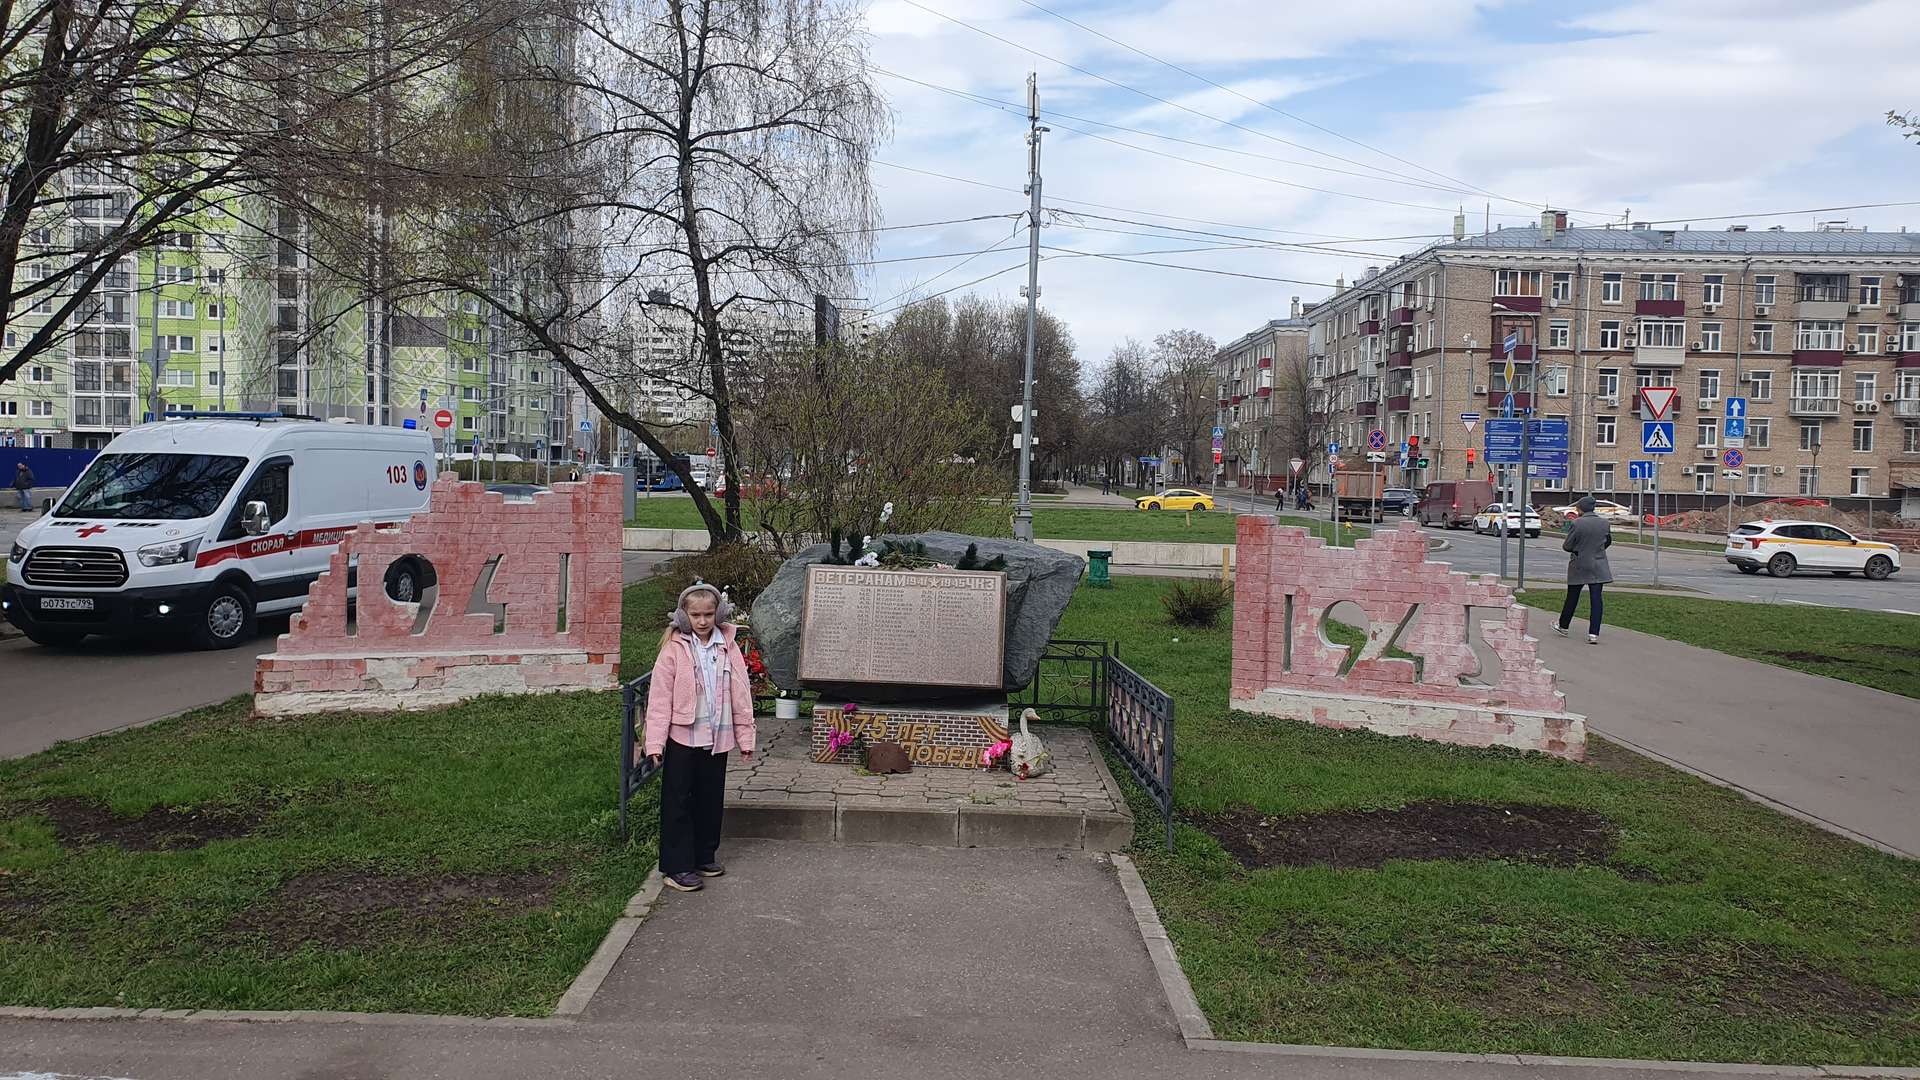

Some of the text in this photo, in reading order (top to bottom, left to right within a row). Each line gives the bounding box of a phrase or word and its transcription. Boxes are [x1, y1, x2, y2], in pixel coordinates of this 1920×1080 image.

[387, 465, 407, 484] 103
[251, 530, 345, 553] СКОРАЯ МЕДИЦИ
[815, 571, 906, 586] ВЕТЕРАНАМ
[966, 577, 995, 590] ЧКЗ
[345, 552, 570, 638] 1941
[1282, 594, 1508, 689] 1945
[852, 714, 940, 742] 75 ЛЕТ
